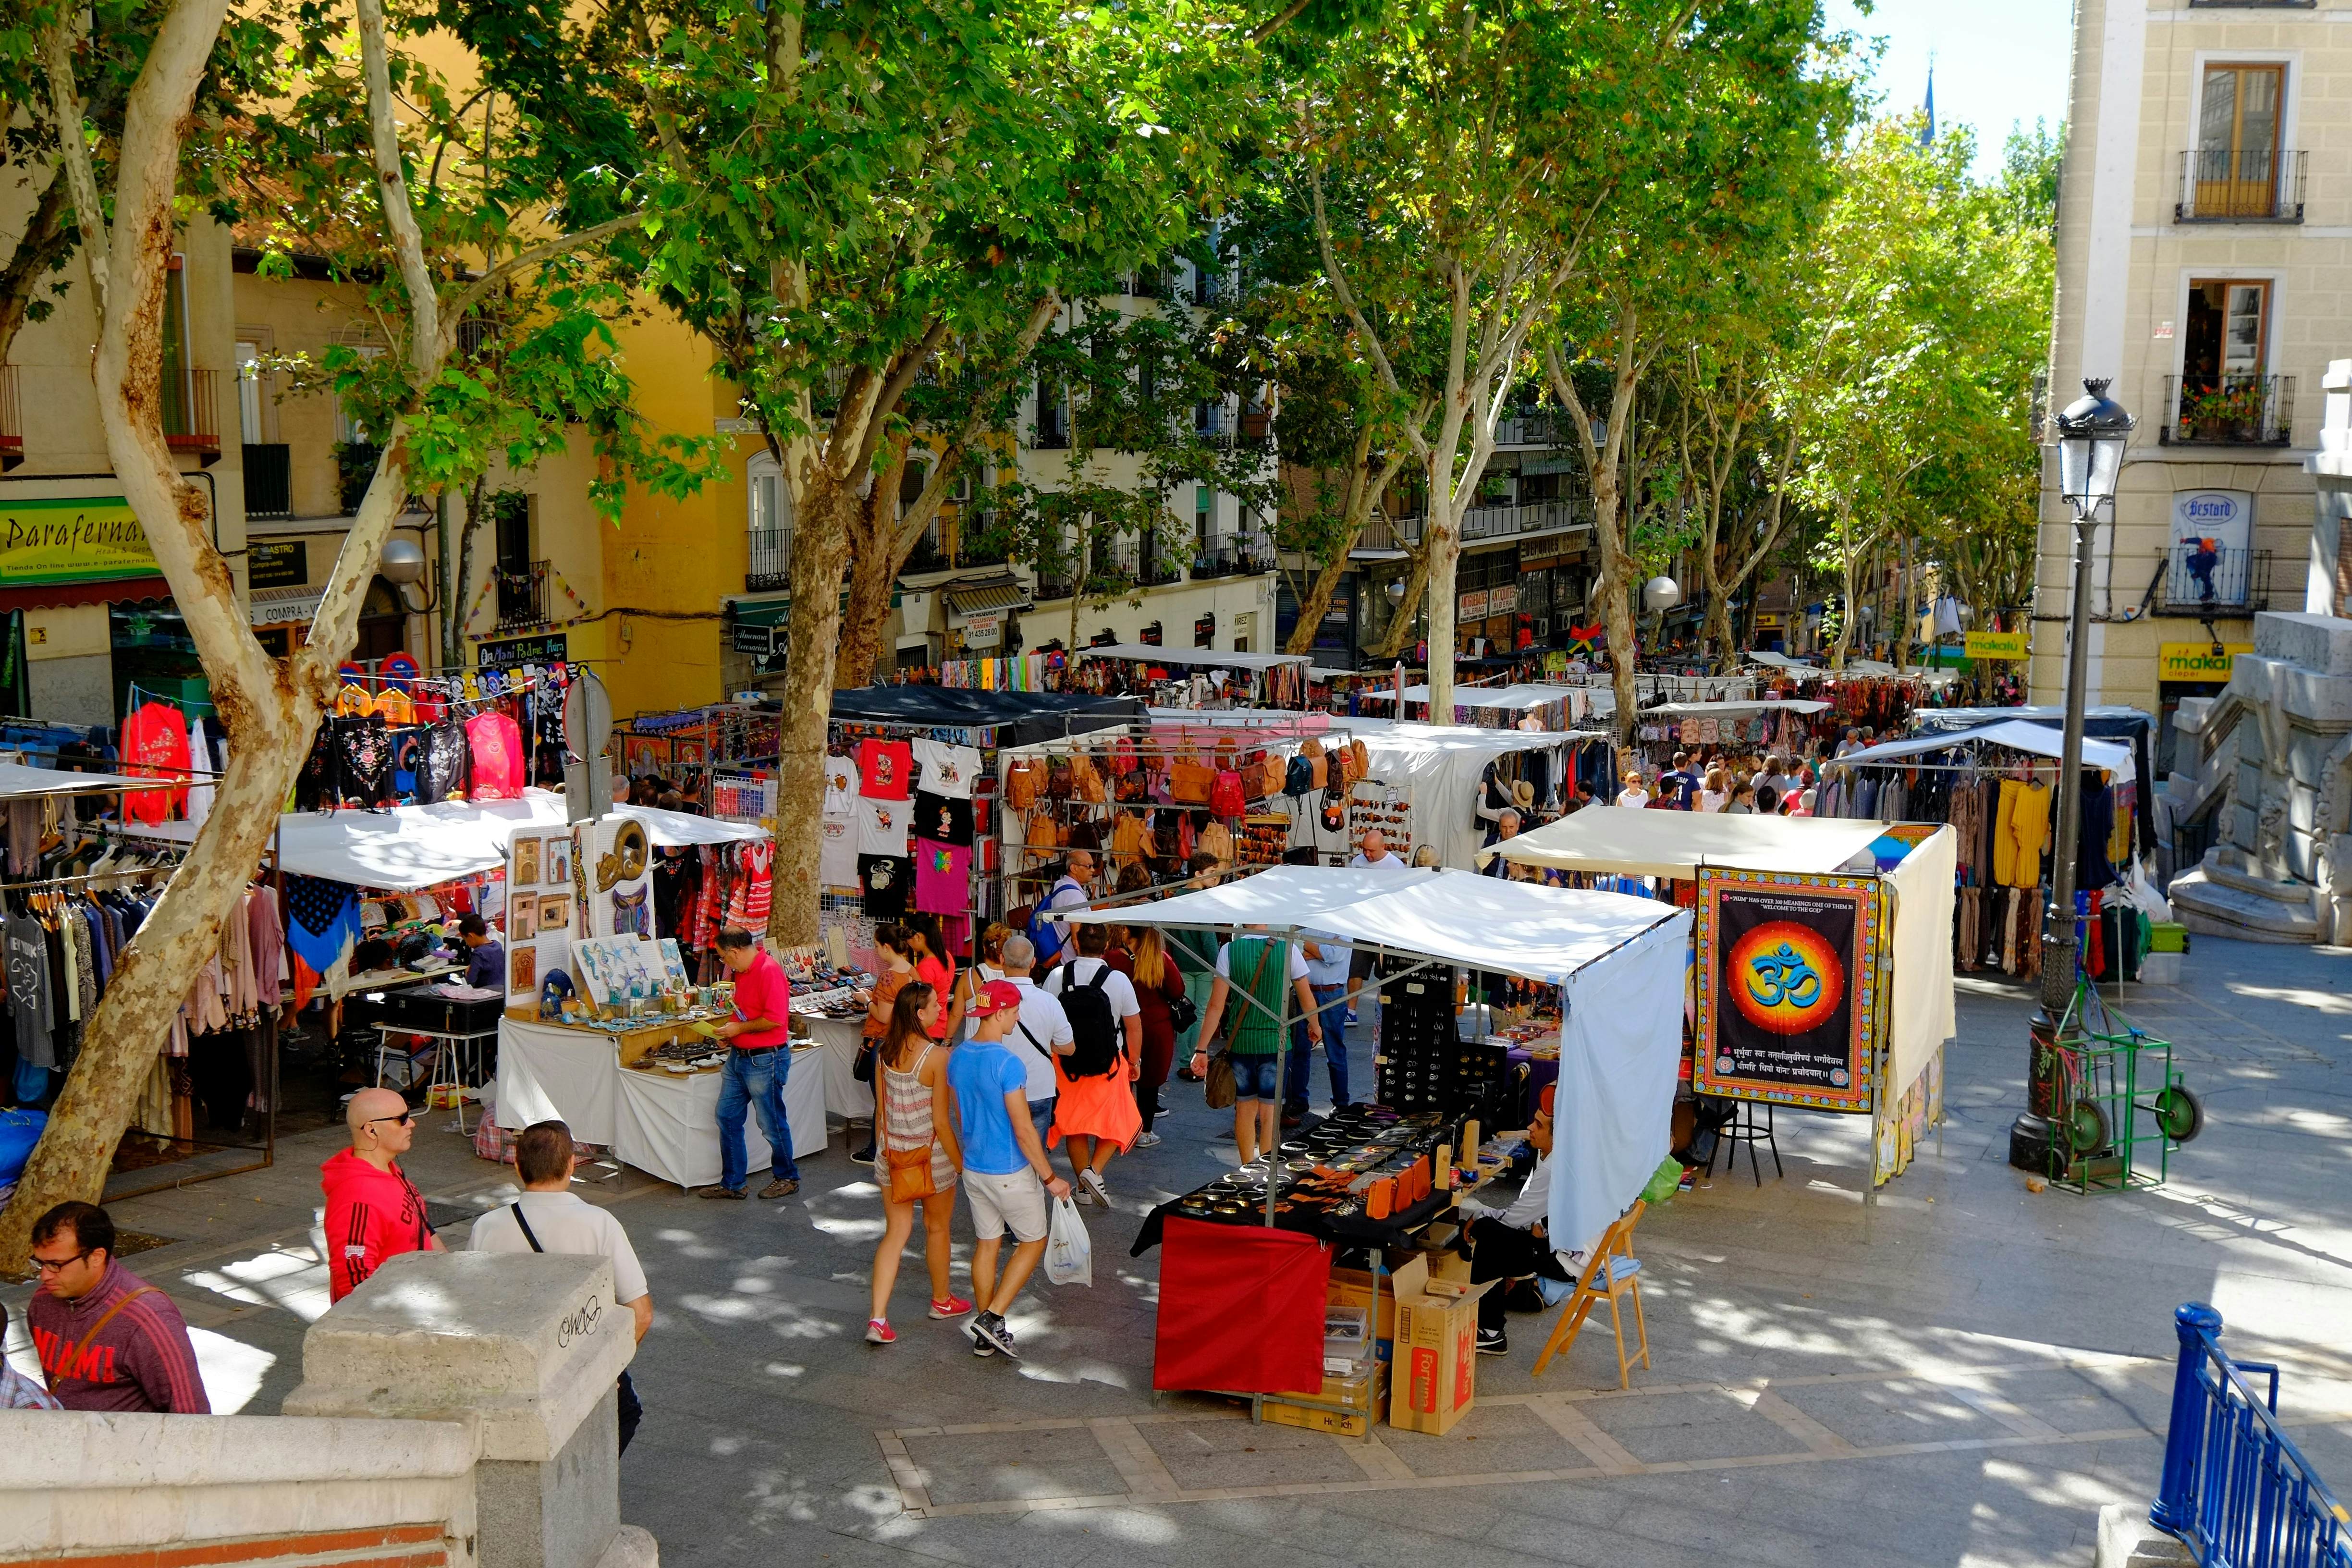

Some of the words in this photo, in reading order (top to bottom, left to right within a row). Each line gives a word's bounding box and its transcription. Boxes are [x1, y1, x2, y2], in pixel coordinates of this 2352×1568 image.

[2190, 500, 2230, 517] Bestard
[96, 548, 117, 556] Head
[1526, 536, 1559, 557] DEPORTES
[1493, 600, 1512, 610] RIBERA
[266, 606, 303, 621] COMPRA
[968, 615, 997, 625] EXCLUSIVAS
[735, 629, 767, 640] Almenara
[968, 630, 974, 639] 91
[975, 629, 984, 638] 435
[991, 627, 997, 636] 00
[516, 642, 543, 659] Padme
[735, 639, 768, 652] Decoración
[1971, 640, 2018, 651] makalu
[33, 1325, 115, 1383] MIAMI
